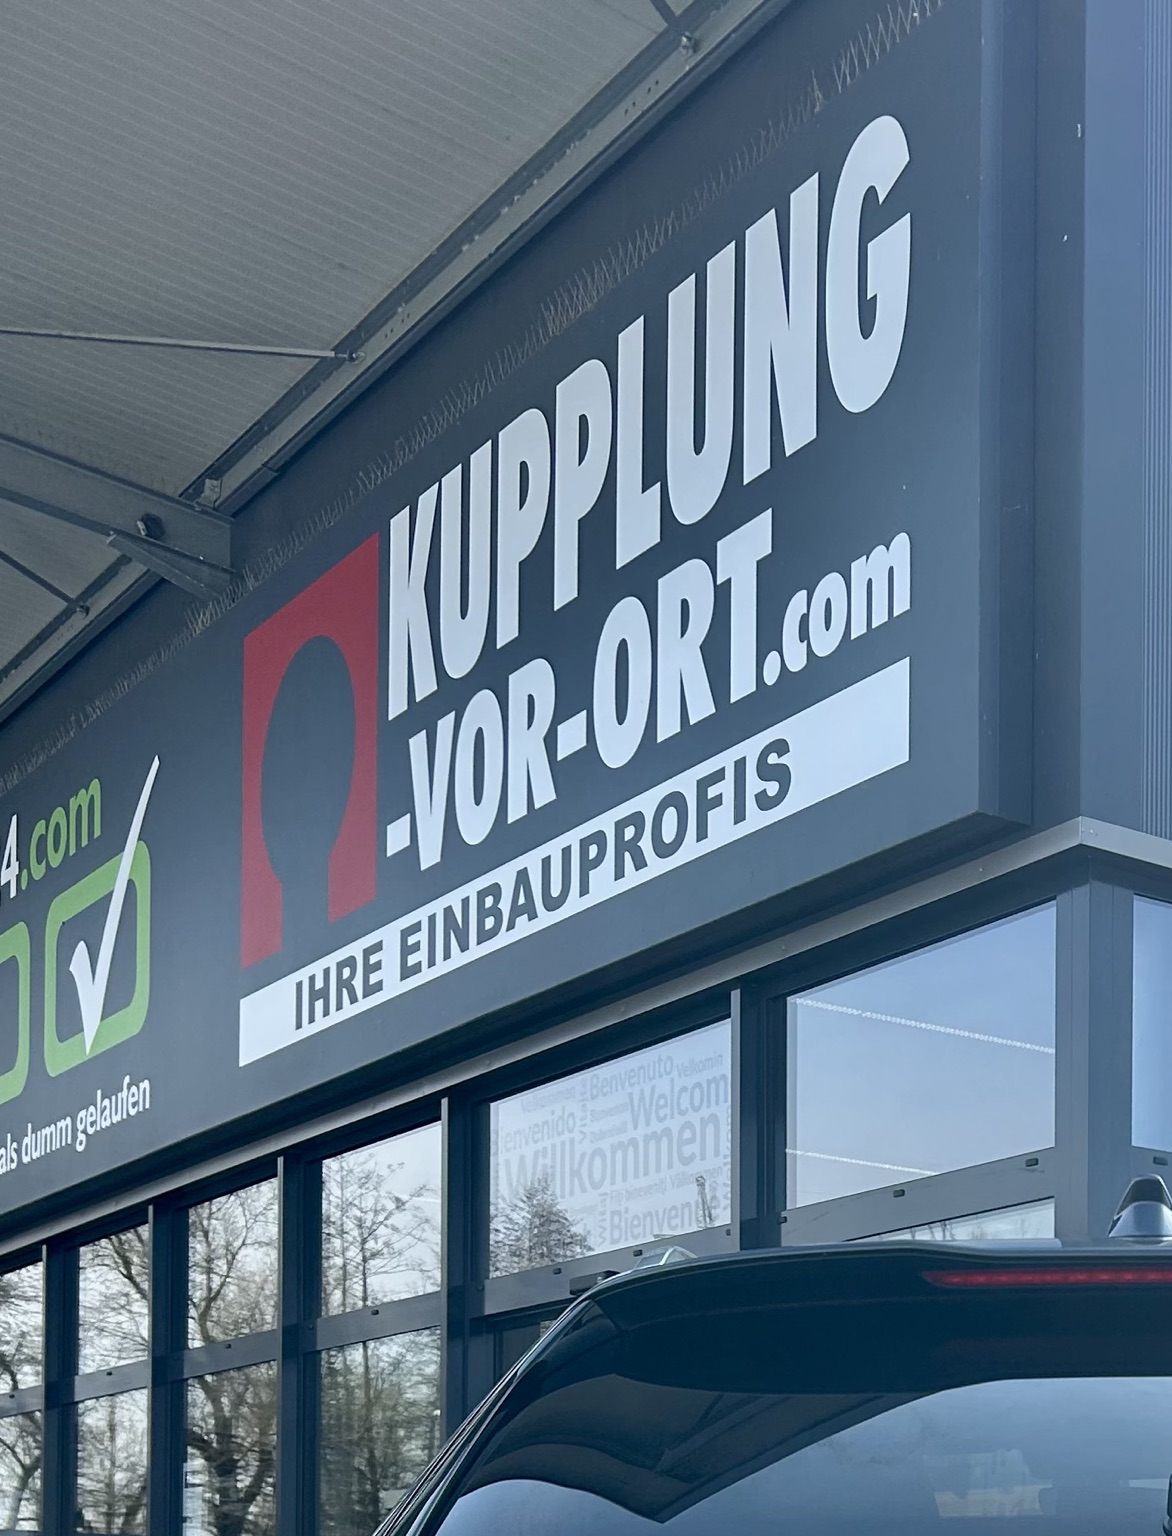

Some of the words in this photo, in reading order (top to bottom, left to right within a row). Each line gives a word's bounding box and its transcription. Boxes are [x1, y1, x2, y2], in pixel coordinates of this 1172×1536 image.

[388, 115, 911, 721] KUPPLUNG
[386, 508, 911, 871] -VOR-ORT.com
[295, 940, 384, 1031] IHRE
[400, 738, 793, 981] EINBAUPROFIS
[21, 1123, 72, 1164] dumm
[75, 1075, 150, 1152] gelaufen
[590, 1054, 674, 1101] Benvenuto
[498, 1106, 576, 1154] ienvenido
[504, 1112, 721, 1202] Willkommen
